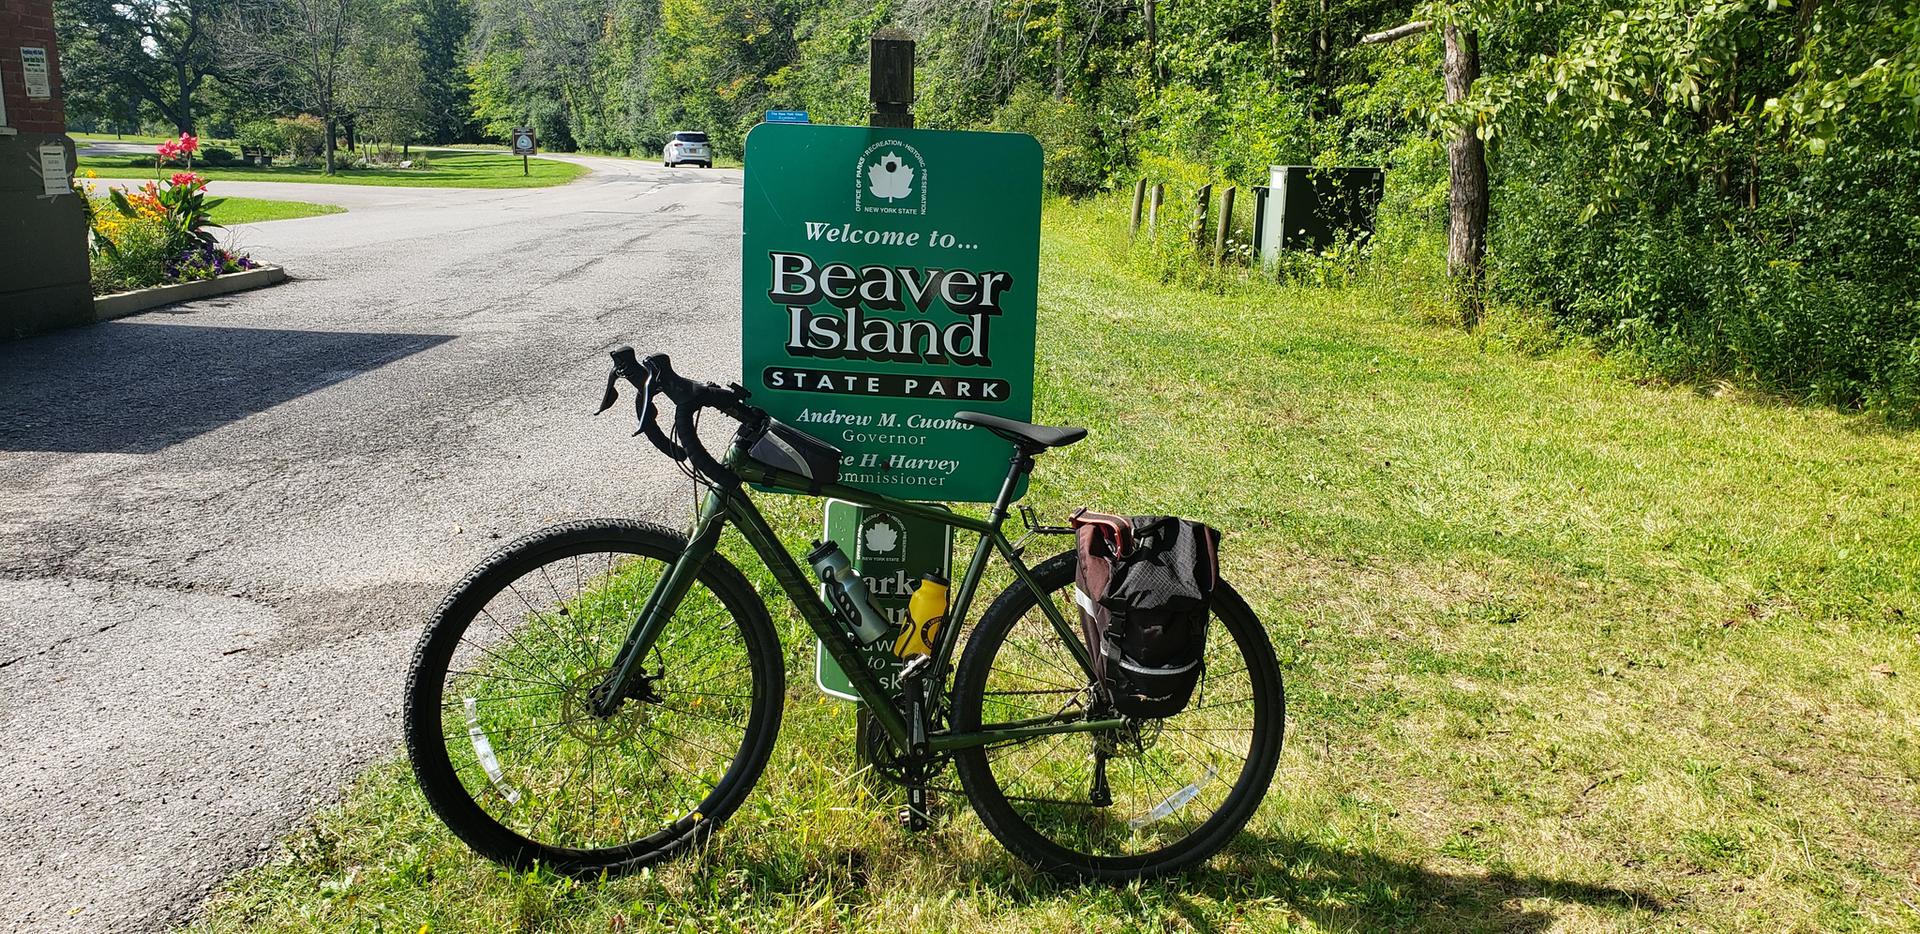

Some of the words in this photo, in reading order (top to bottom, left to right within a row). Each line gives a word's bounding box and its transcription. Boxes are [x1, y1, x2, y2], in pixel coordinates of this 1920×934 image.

[864, 139, 903, 156] RECREATION
[905, 143, 926, 168] HISTORIC
[856, 156, 866, 178] PARKS
[855, 179, 862, 188] OF
[920, 168, 928, 216] PRESERVATION
[898, 207, 918, 215] STATE
[804, 221, 920, 247] Welcome
[929, 229, 978, 250] to...
[769, 252, 1008, 310] Beaver
[786, 306, 985, 359] Island
[771, 370, 880, 393] STATE
[905, 378, 1000, 398] PARK
[796, 407, 872, 427] Andrew
[877, 412, 901, 428] M.
[842, 429, 927, 446] Governor
[858, 453, 882, 467] H.
[888, 454, 960, 475] Harvey
[837, 471, 946, 486] ommissioner
[863, 569, 916, 596] ark
[867, 655, 886, 670] to
